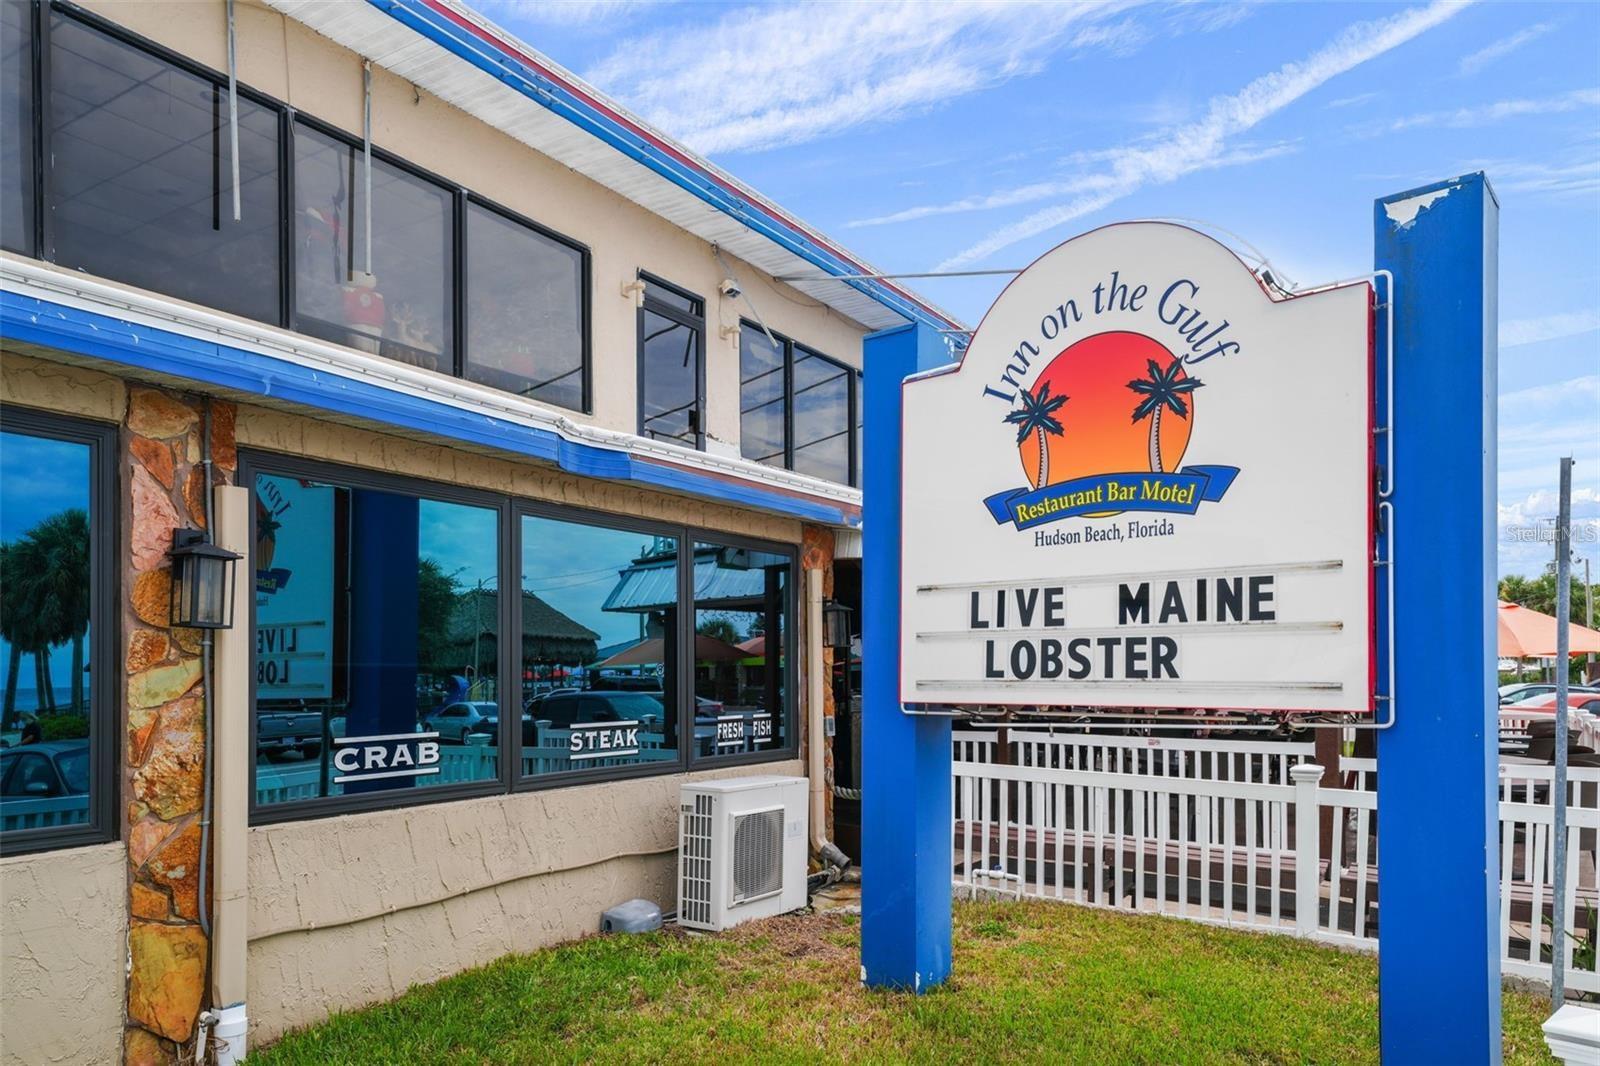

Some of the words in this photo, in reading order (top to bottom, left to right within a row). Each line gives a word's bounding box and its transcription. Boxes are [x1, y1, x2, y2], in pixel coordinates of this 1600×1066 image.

[983, 340, 1040, 405] Inn
[1041, 299, 1083, 340] on
[1092, 271, 1148, 314] the
[1158, 279, 1240, 364] Gulf
[1016, 485, 1103, 523] Restaurant
[1107, 481, 1137, 501] Bar
[1140, 479, 1196, 505] Motel
[1034, 529, 1081, 547] Hudson
[1084, 525, 1125, 543] Beach,
[1128, 519, 1175, 540] Florida
[970, 587, 1065, 629] LIVE
[1119, 575, 1276, 625] MAINE
[985, 636, 1180, 680] LOBSTER
[570, 728, 639, 752] STEAK
[717, 721, 744, 740] FRESH
[752, 719, 772, 737] FISH
[334, 741, 440, 773] CRAB
